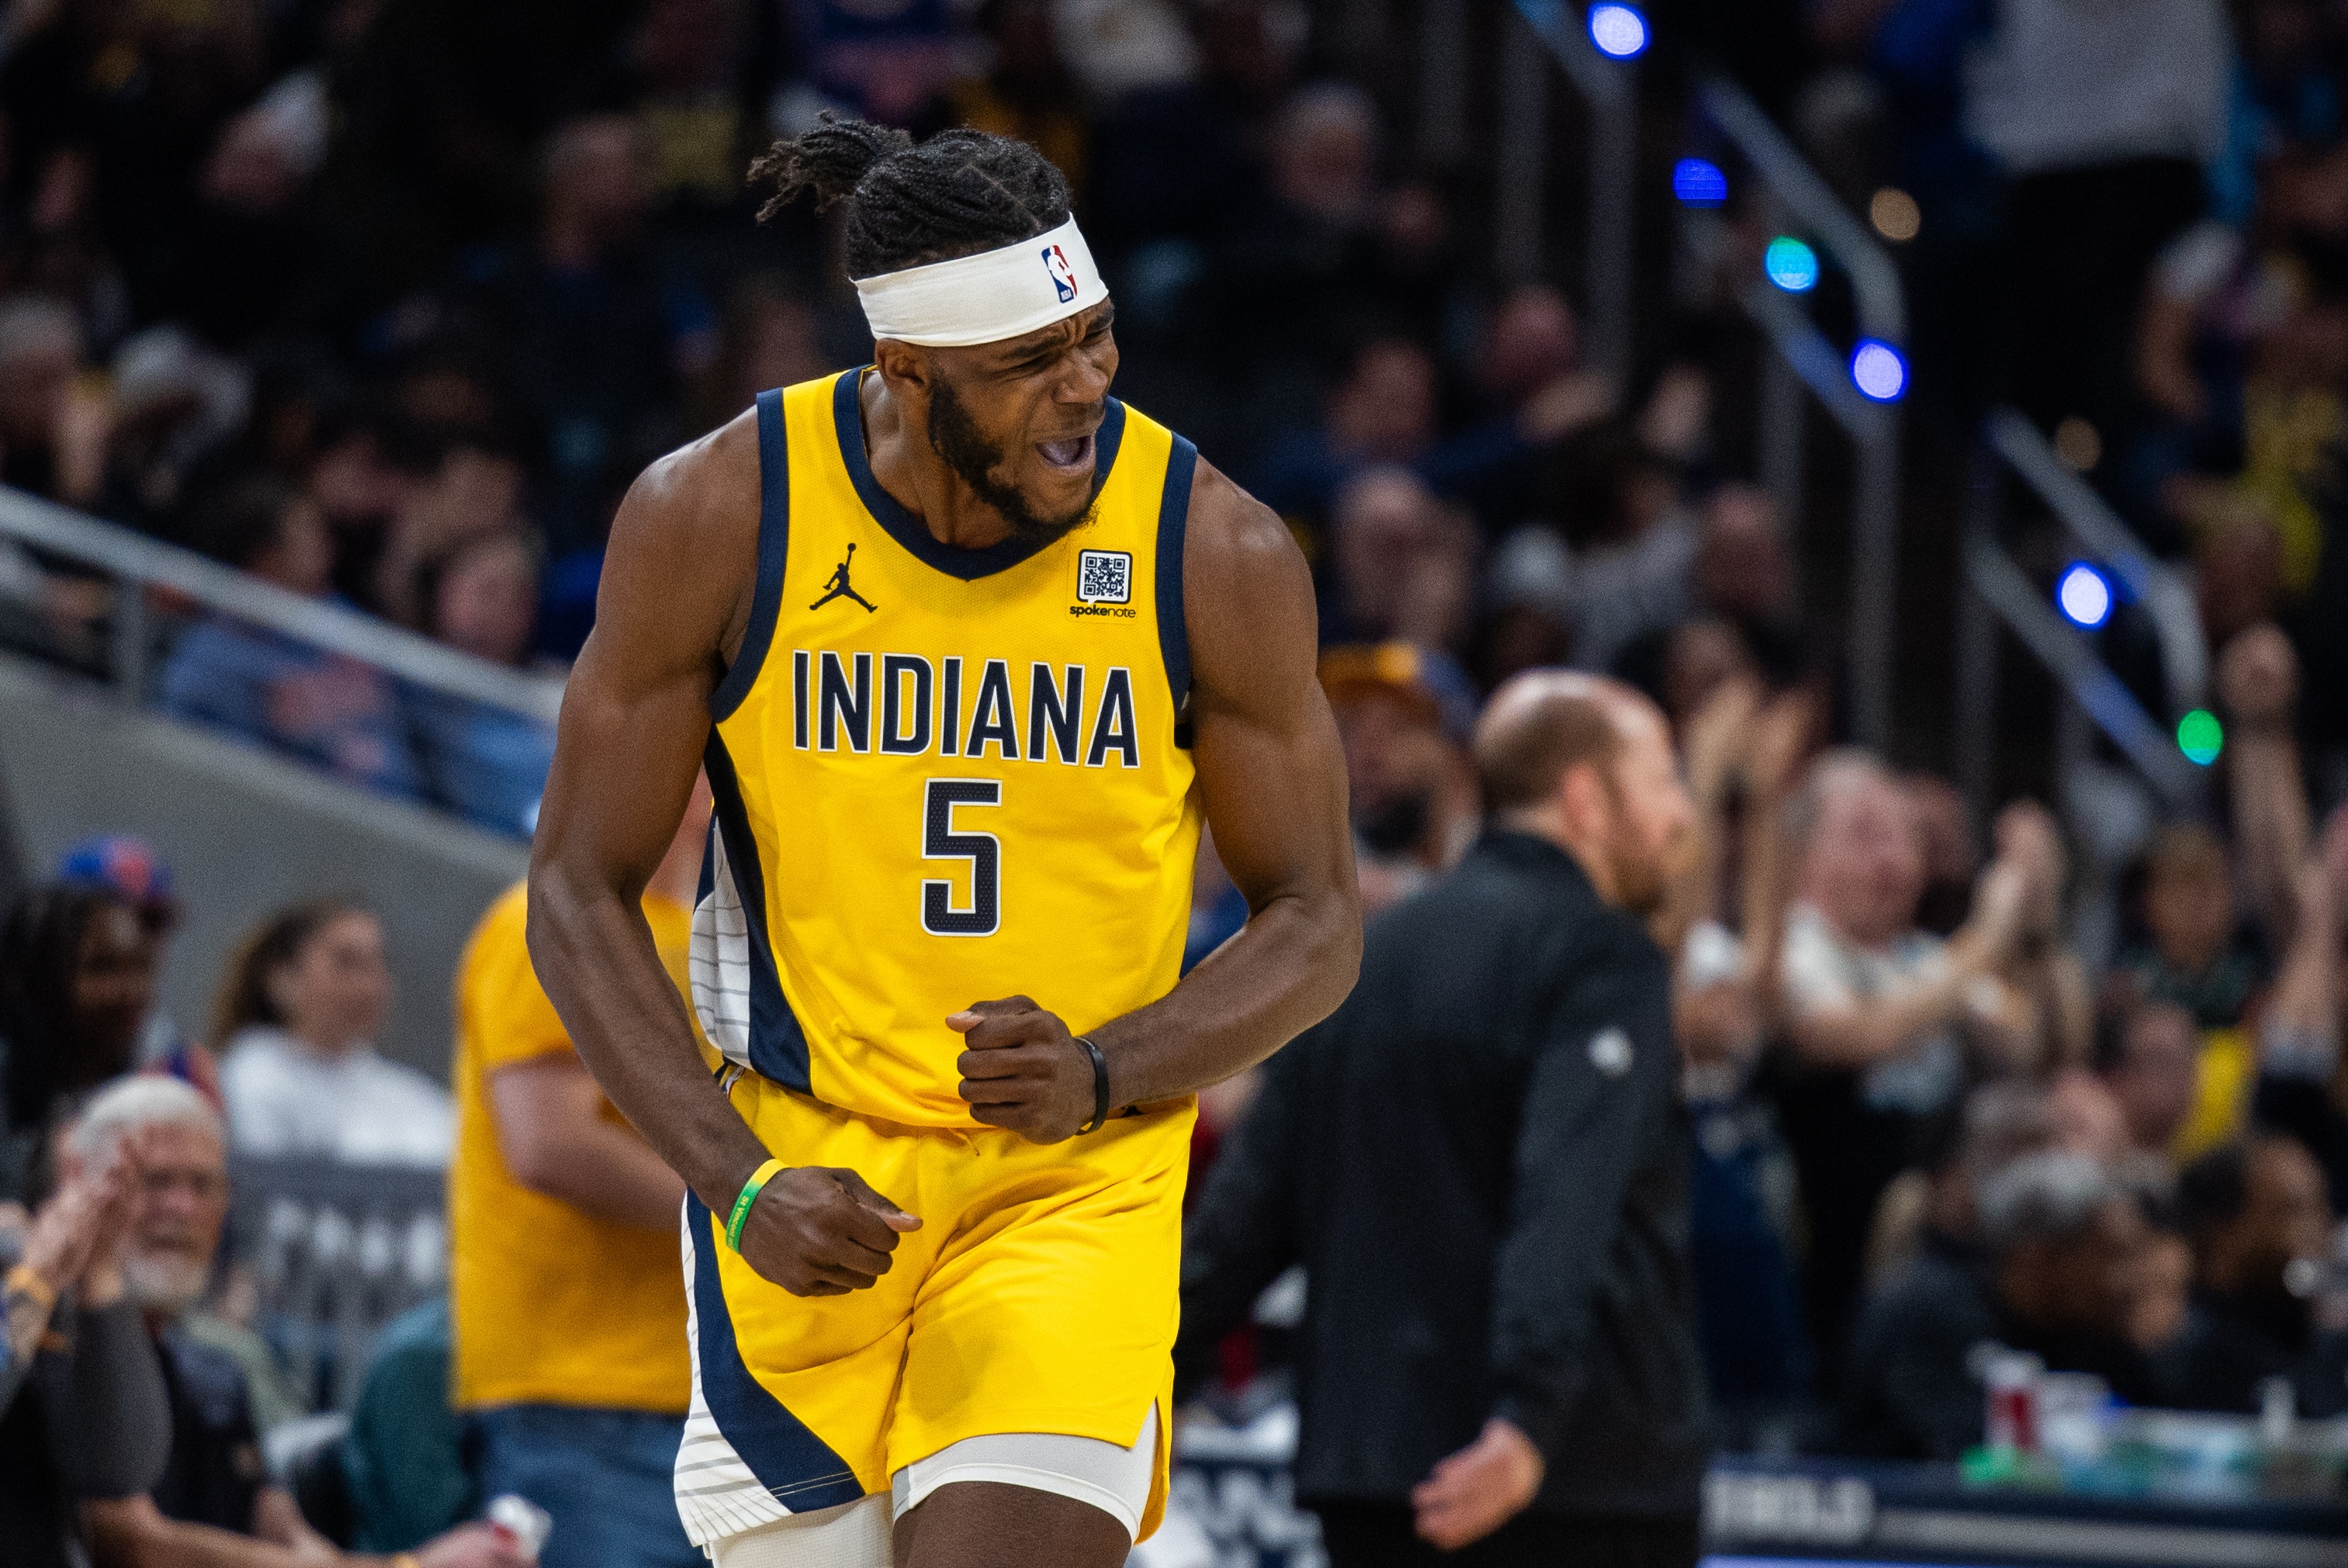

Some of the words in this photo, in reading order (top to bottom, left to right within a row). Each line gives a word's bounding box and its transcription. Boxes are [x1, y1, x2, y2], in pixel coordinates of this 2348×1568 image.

[1061, 289, 1072, 300] NBA
[1070, 604, 1136, 618] spokenote
[792, 649, 1140, 769] INDIANA
[921, 778, 1003, 937] 5
